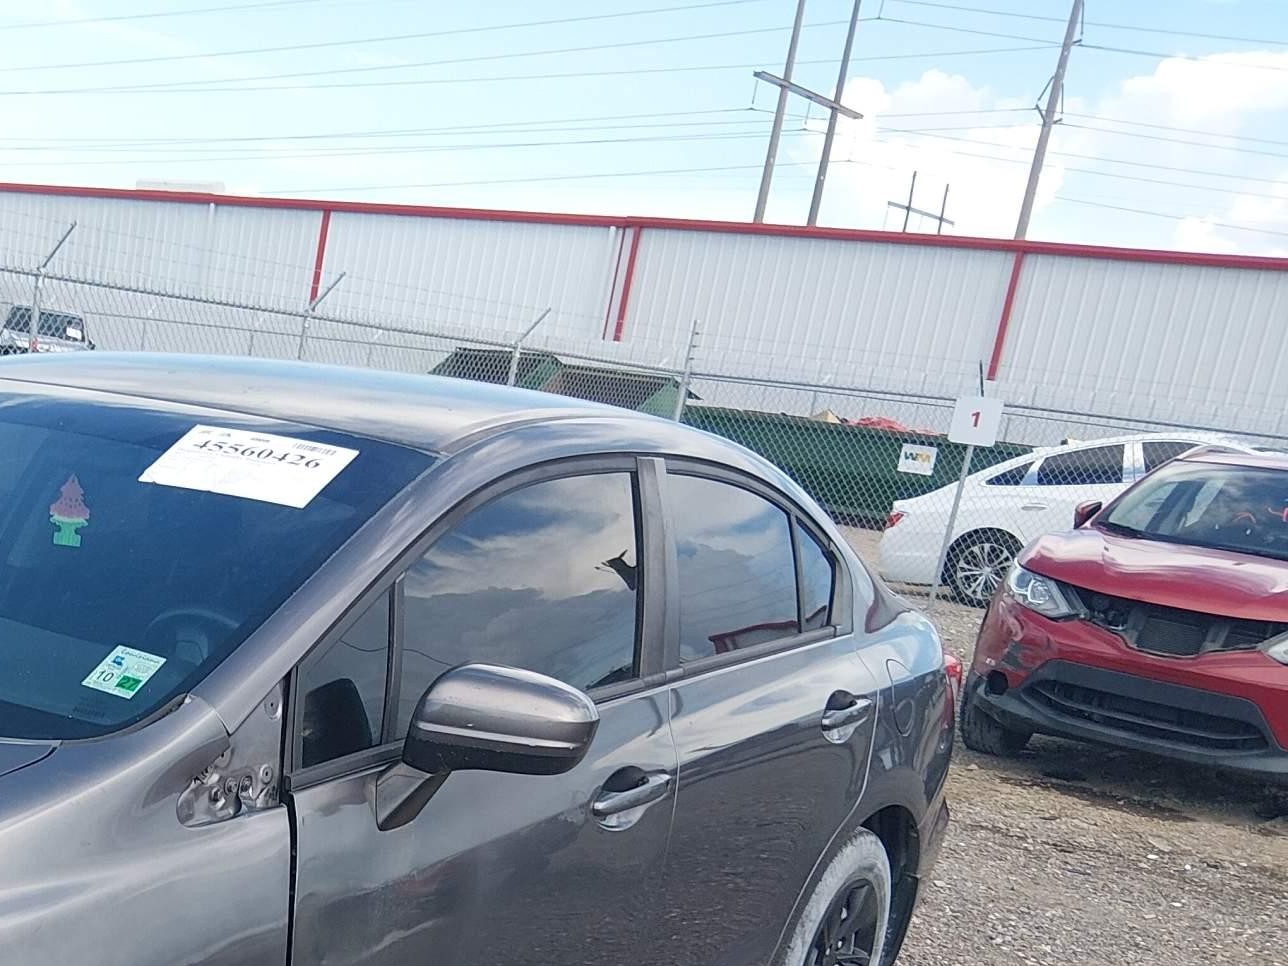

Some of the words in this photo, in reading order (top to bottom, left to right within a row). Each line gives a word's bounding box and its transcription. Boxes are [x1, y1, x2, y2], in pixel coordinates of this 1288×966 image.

[971, 411, 981, 428] 1
[193, 439, 321, 469] 45560426
[96, 670, 115, 683] 10
